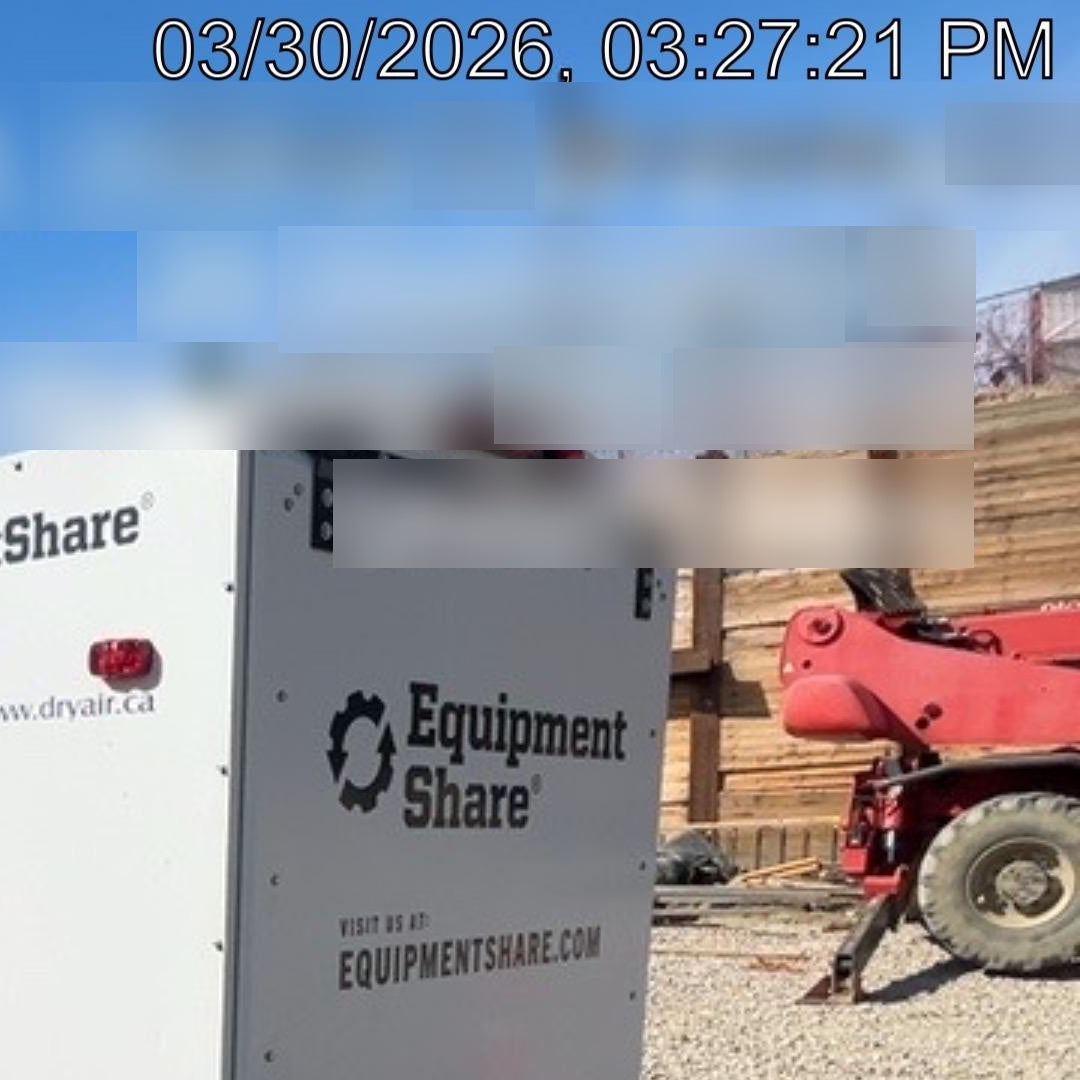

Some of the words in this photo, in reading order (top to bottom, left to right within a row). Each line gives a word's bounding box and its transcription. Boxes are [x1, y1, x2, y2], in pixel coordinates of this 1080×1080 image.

[406, 680, 628, 768] Equipment
[403, 765, 530, 829] Share
[339, 915, 380, 938] VISIT
[385, 913, 404, 934] US
[338, 926, 602, 991] EQUIPMENTSHARE.COM
